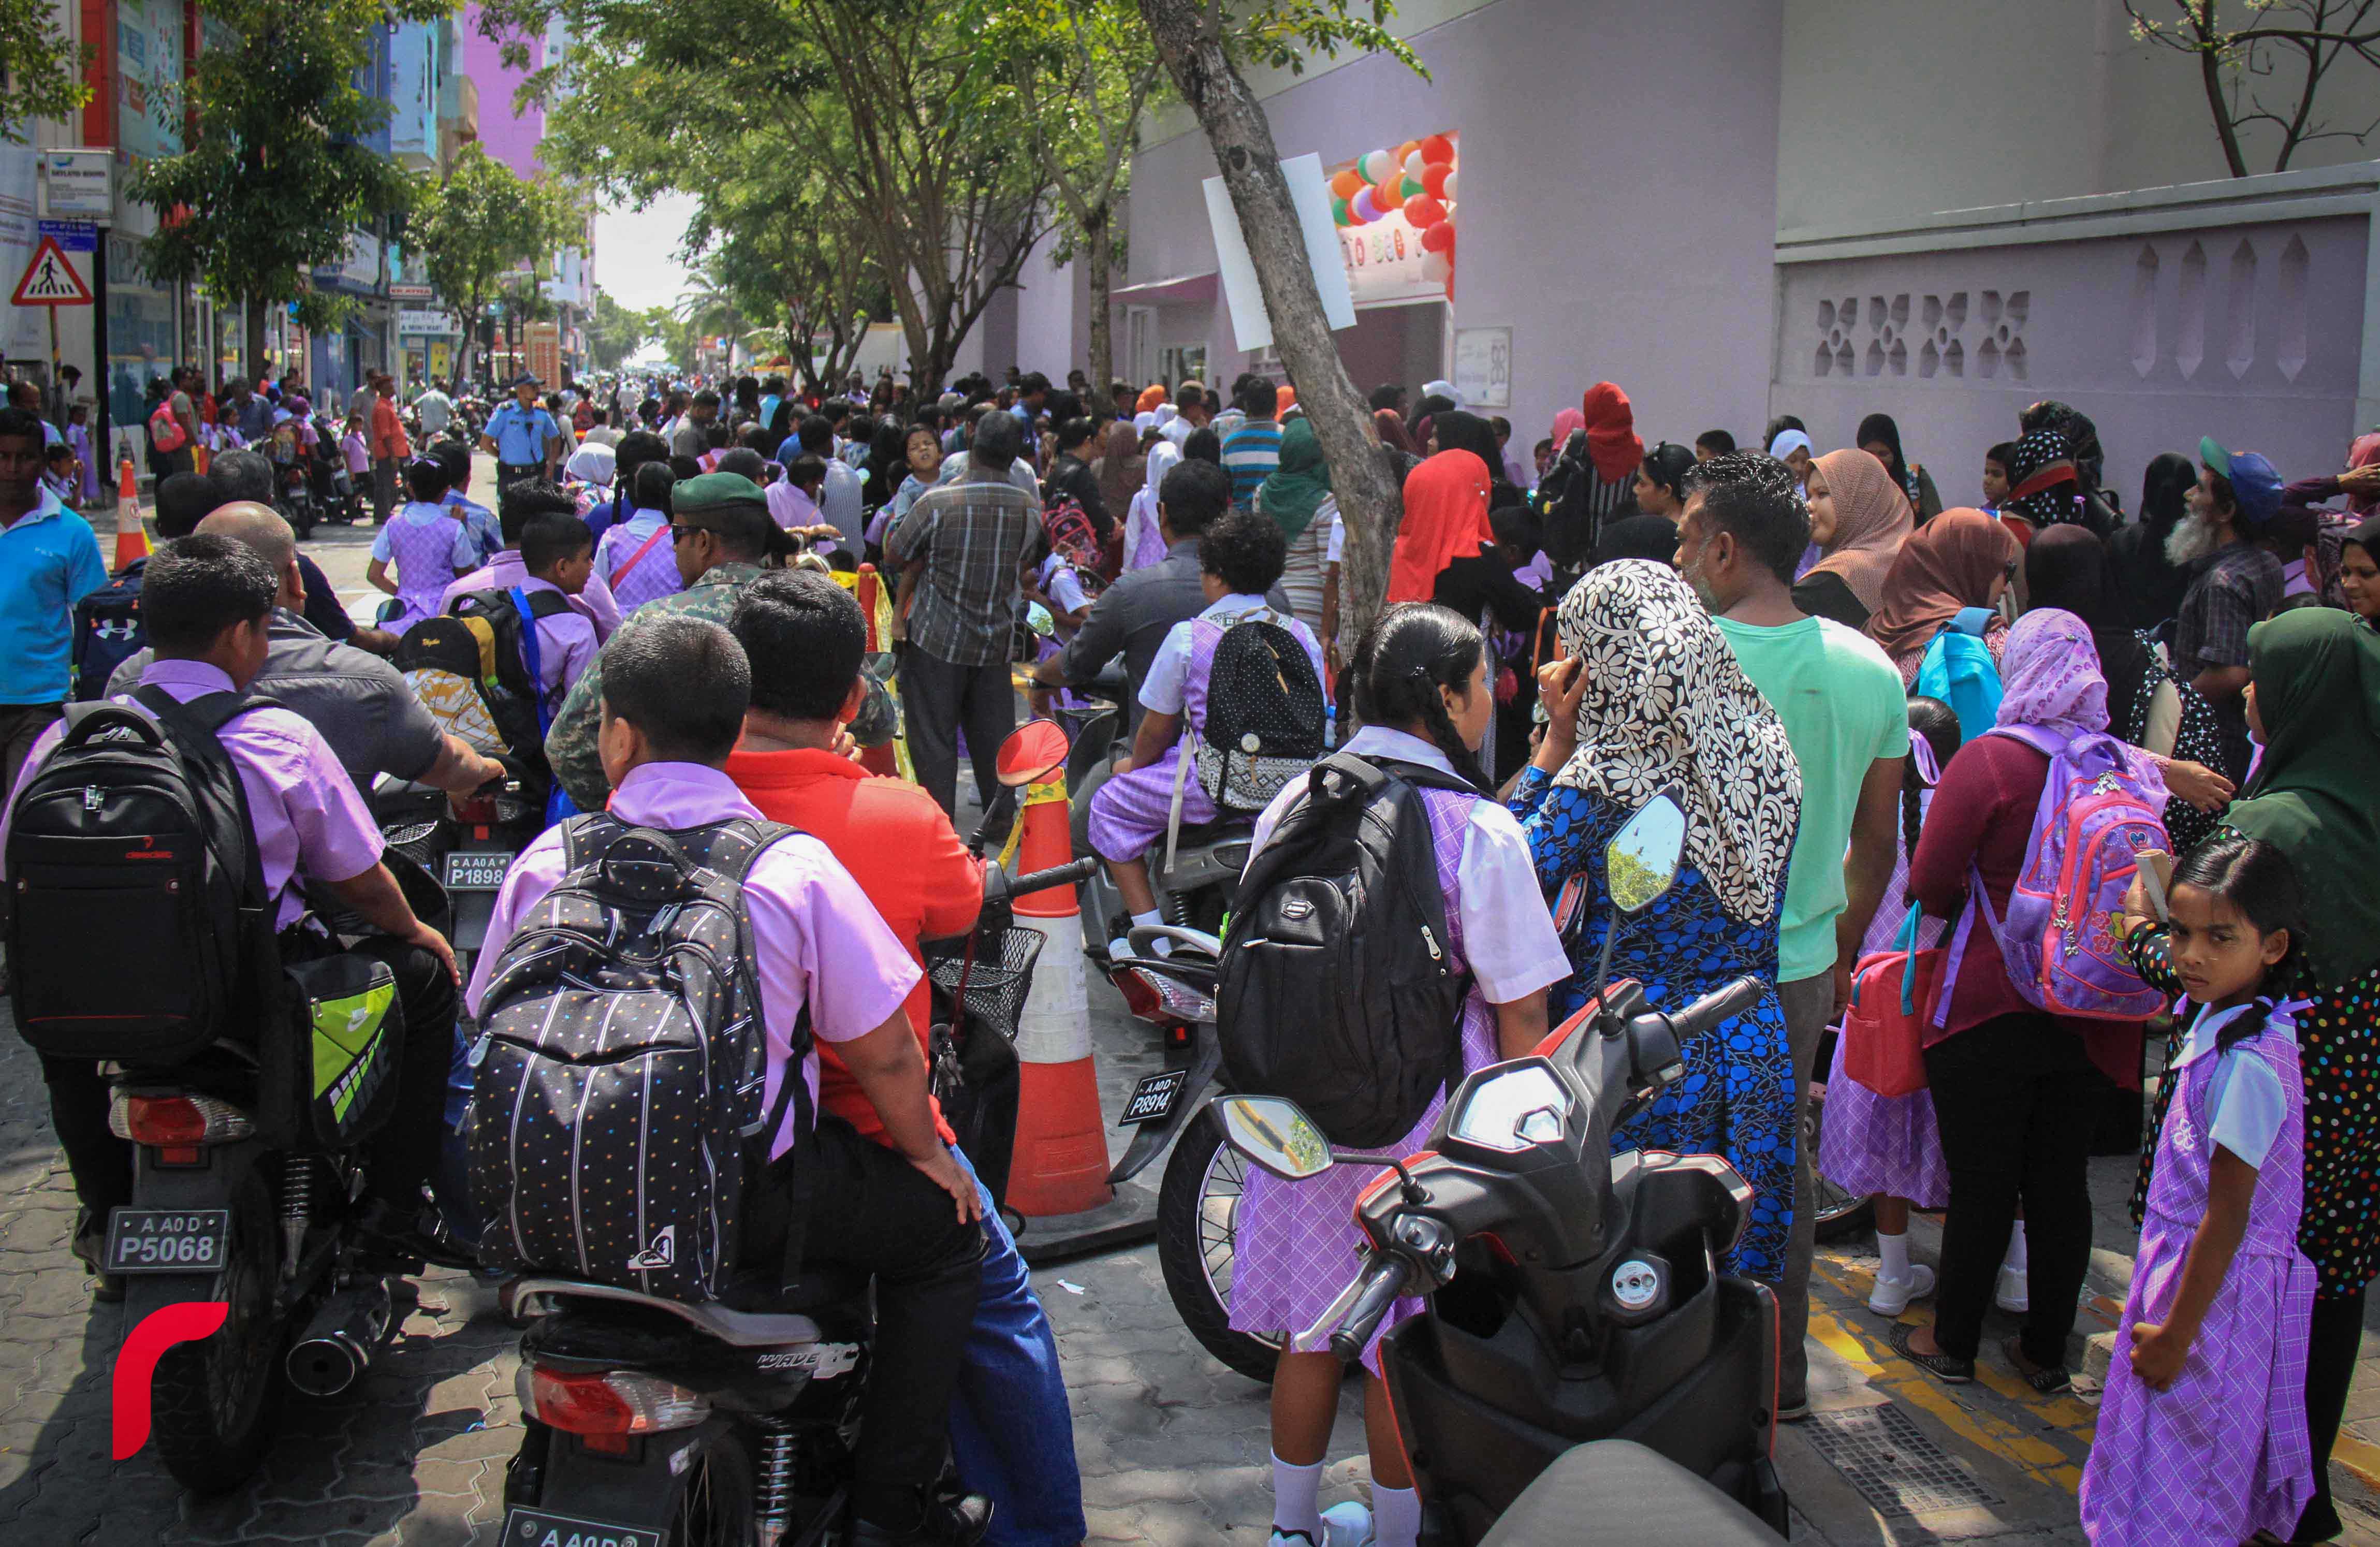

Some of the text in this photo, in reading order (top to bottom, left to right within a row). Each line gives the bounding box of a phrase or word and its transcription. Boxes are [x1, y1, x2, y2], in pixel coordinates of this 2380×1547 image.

[451, 868, 504, 885] P1898
[1129, 1091, 1172, 1116] P8914
[118, 1236, 214, 1262] P5068
[756, 1352, 820, 1368] WAVE
